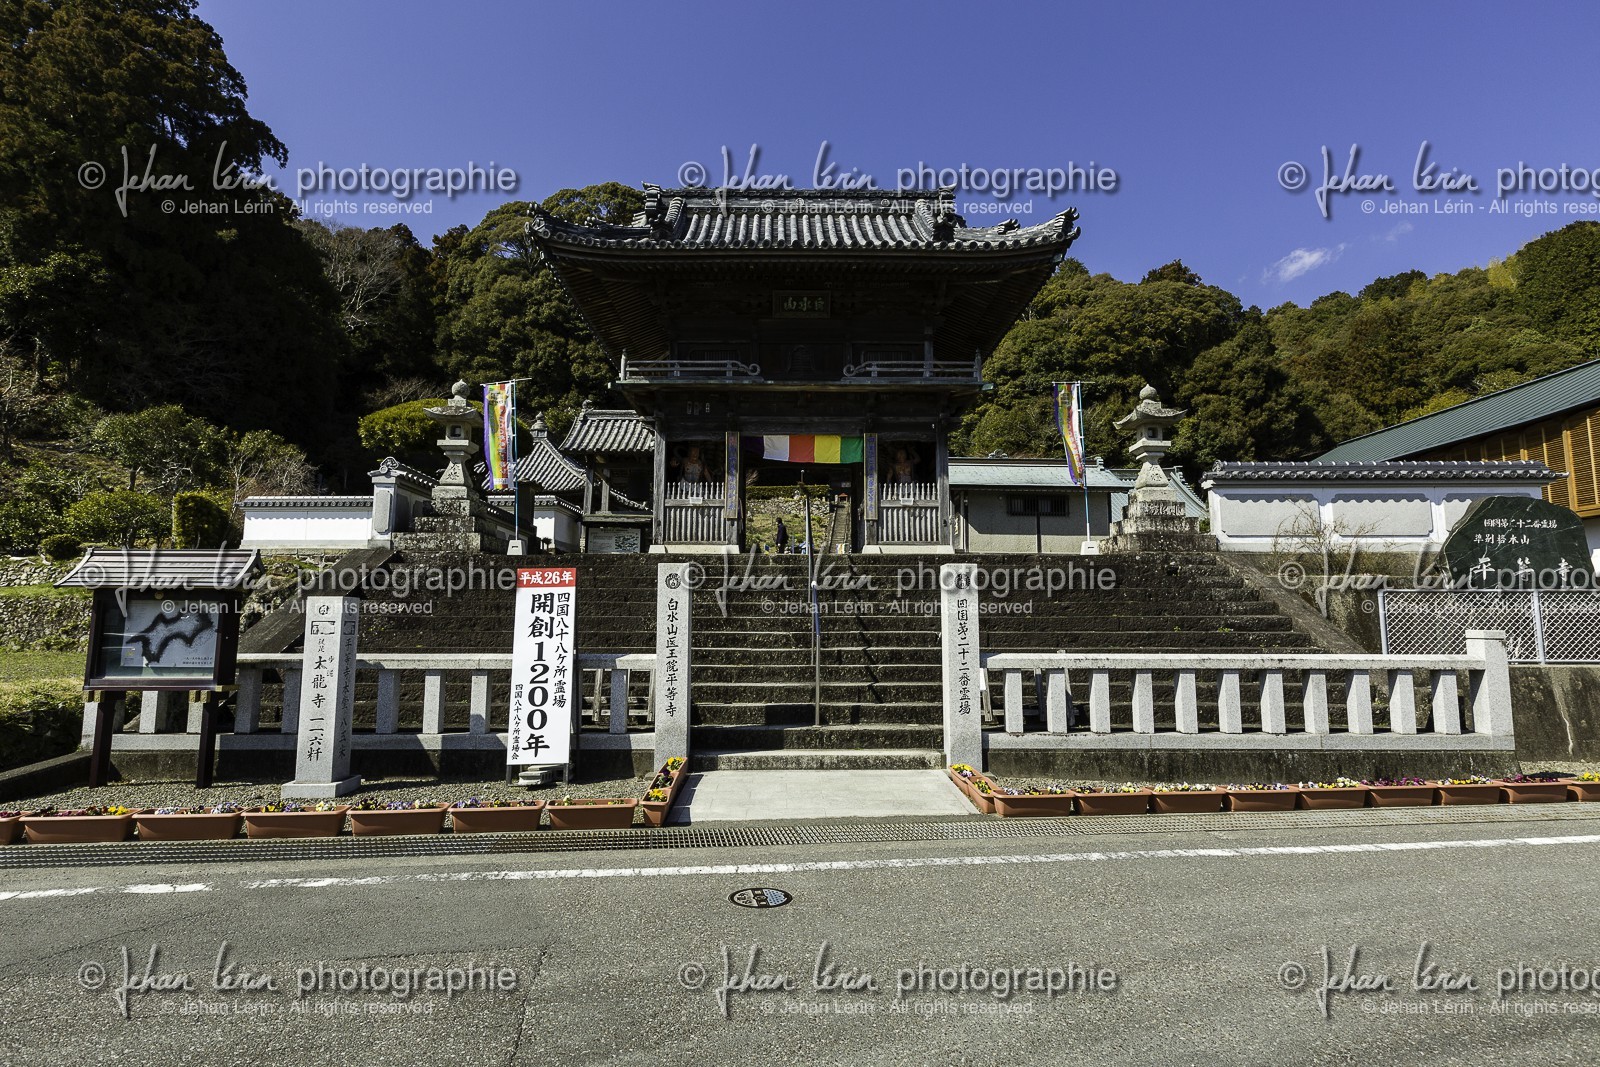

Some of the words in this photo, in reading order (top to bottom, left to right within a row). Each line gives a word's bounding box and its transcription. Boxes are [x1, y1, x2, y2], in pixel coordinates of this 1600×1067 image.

[519, 571, 573, 585] 平成26年
[522, 592, 555, 757] 開創1200年
